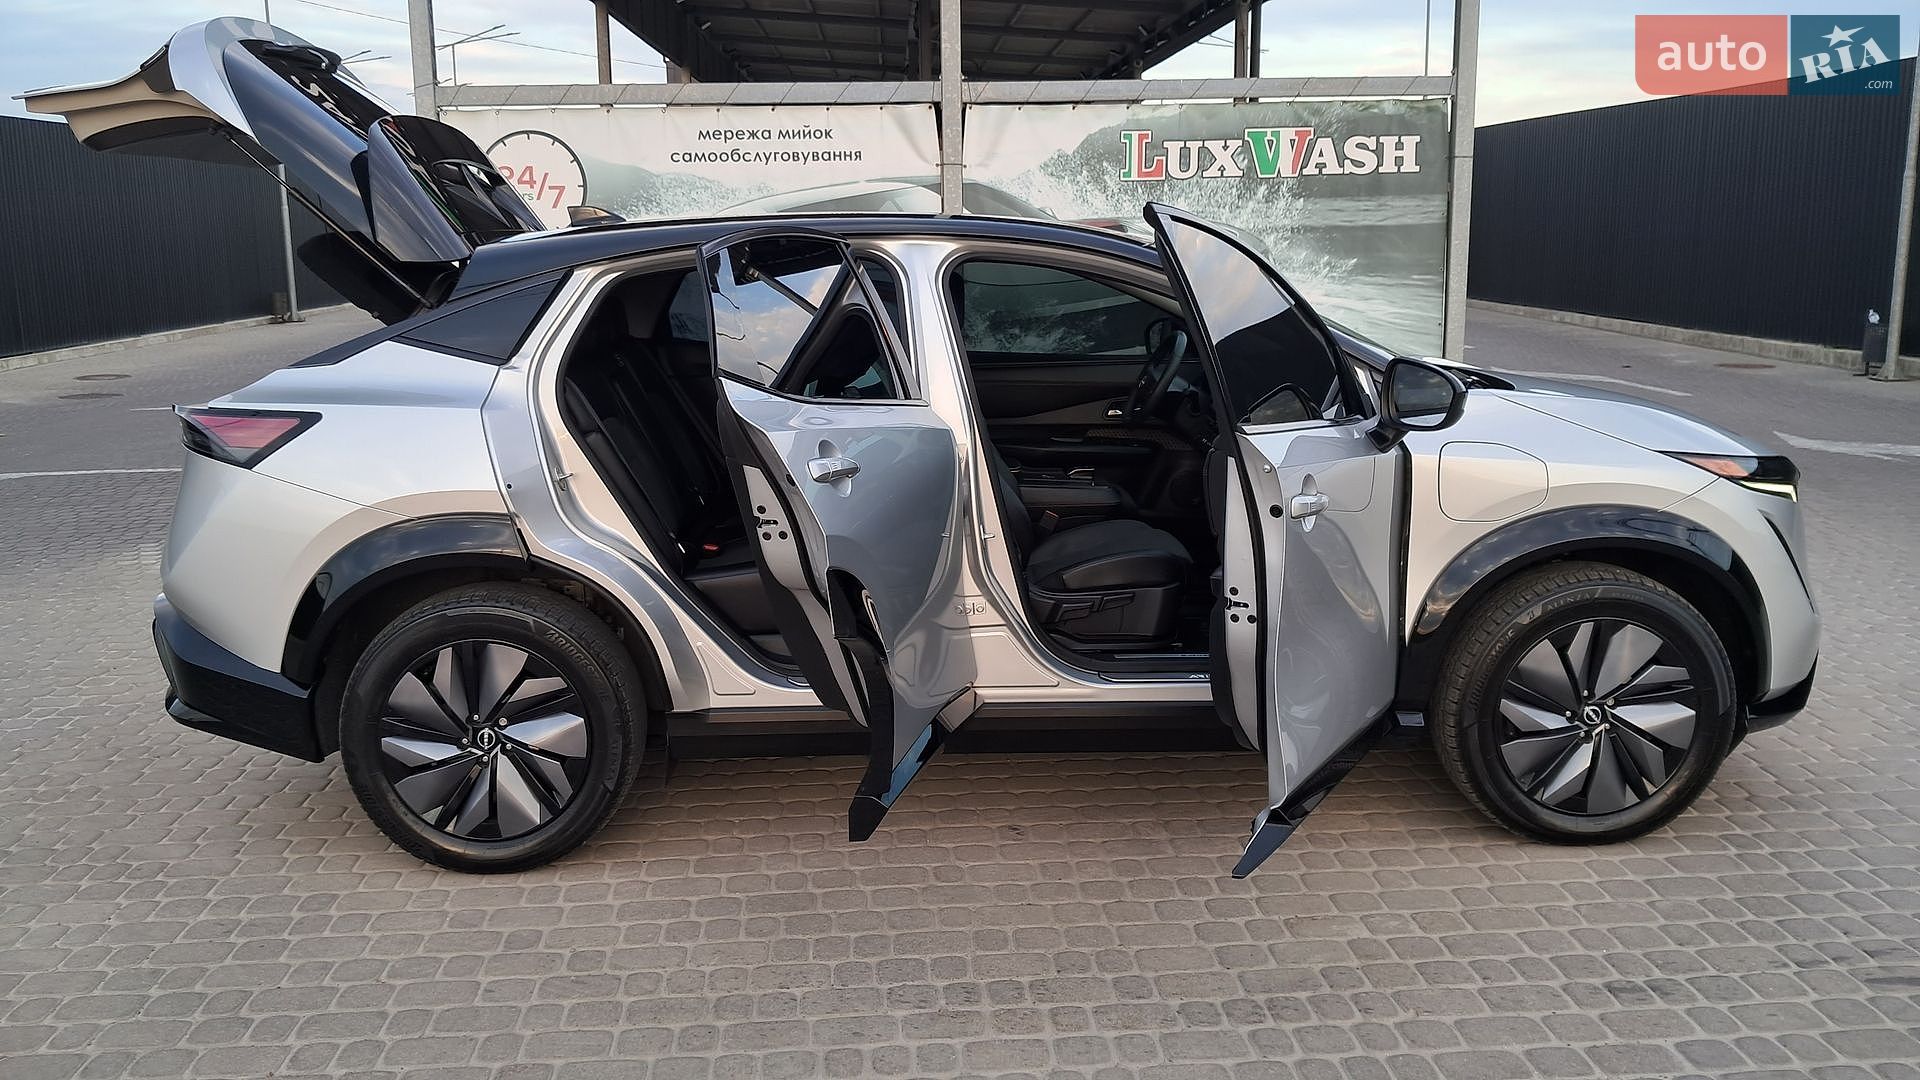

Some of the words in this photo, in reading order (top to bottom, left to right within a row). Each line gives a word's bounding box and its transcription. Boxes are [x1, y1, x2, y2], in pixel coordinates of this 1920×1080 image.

[698, 127, 772, 143] мережа
[777, 125, 833, 140] мийок
[670, 148, 862, 165] самообслуговування
